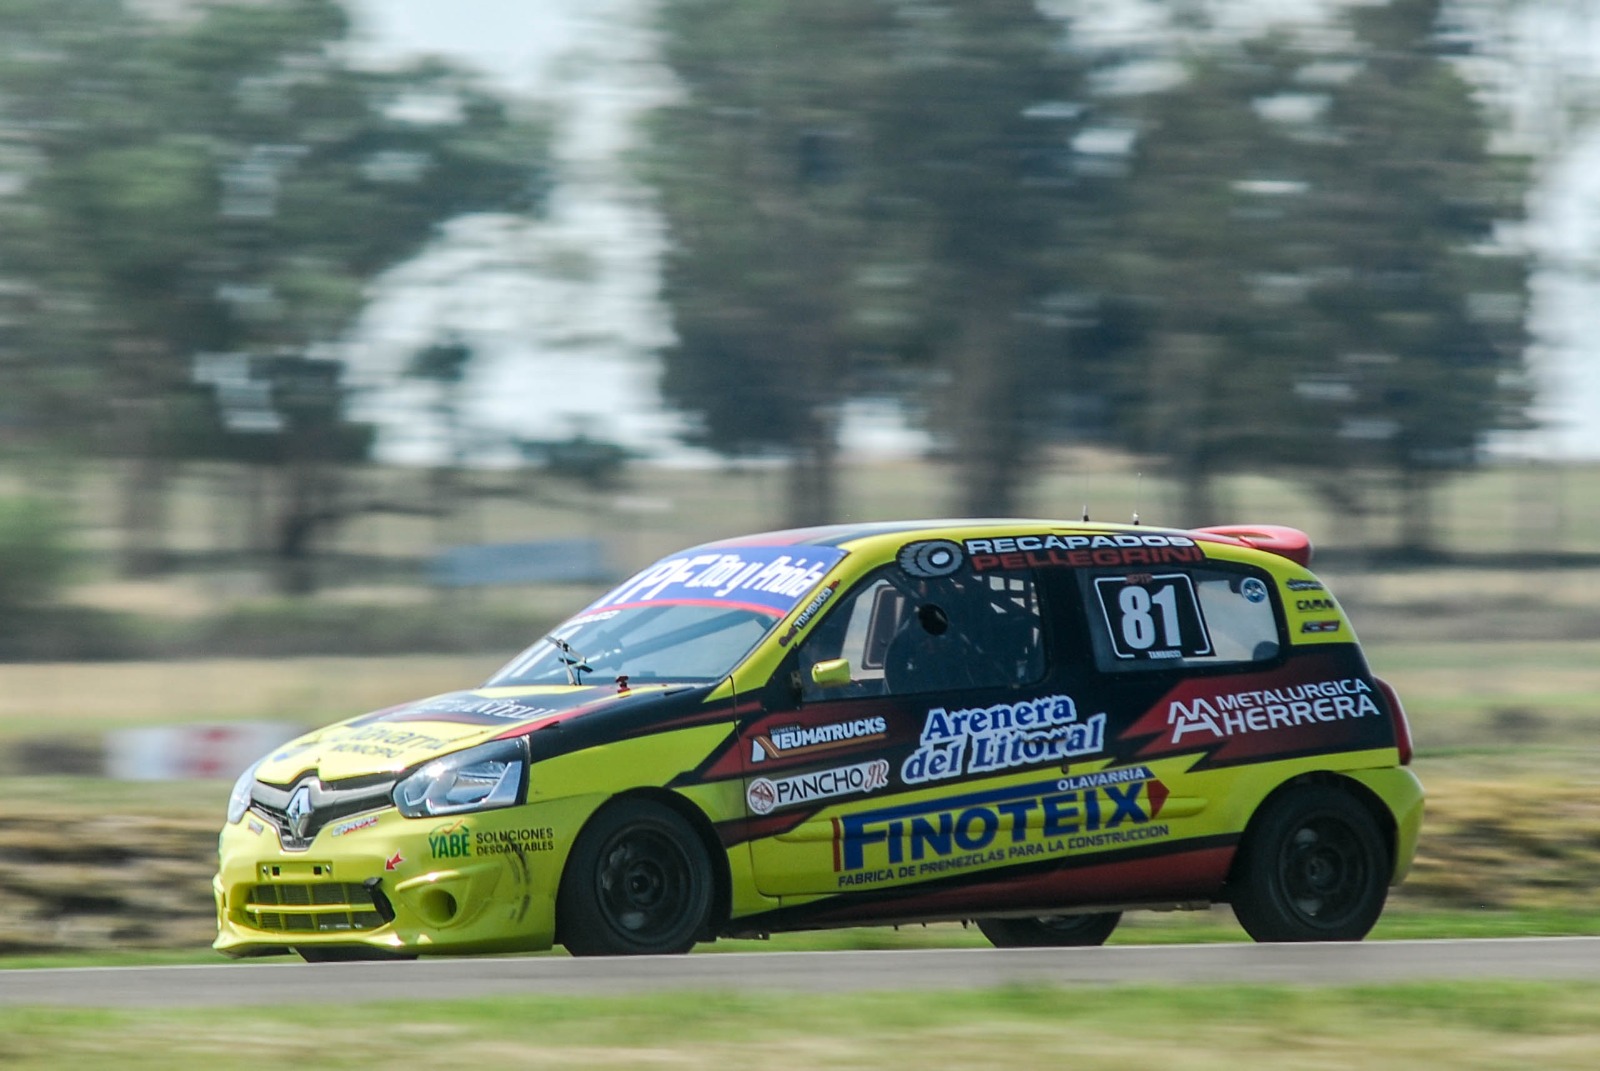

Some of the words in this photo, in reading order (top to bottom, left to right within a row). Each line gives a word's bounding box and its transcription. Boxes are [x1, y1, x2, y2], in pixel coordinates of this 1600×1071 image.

[966, 535, 1195, 555] RECAPADOS
[971, 546, 1204, 571] PELLEGRINI
[1119, 585, 1181, 649] 81
[1216, 678, 1371, 711] METALURGICA
[1222, 694, 1380, 735] HERRERA
[922, 696, 1075, 743] Arenera
[903, 743, 964, 781] del
[971, 716, 1103, 771] Litoral
[777, 768, 863, 803] PANCHO
[864, 762, 887, 789] JR
[1057, 768, 1145, 791] OLAVARRIA
[476, 828, 553, 844] SOLUCIONES
[841, 782, 1152, 871] FINOTEIX
[476, 841, 554, 856] DESCARTABLES
[838, 868, 894, 887] FABRICA
[899, 865, 916, 879] DE
[920, 849, 1005, 874] PREMEZCLAS
[1008, 844, 1044, 860] PARA
[1048, 840, 1064, 853] LA
[1068, 825, 1169, 849] CONSTRUCCION
